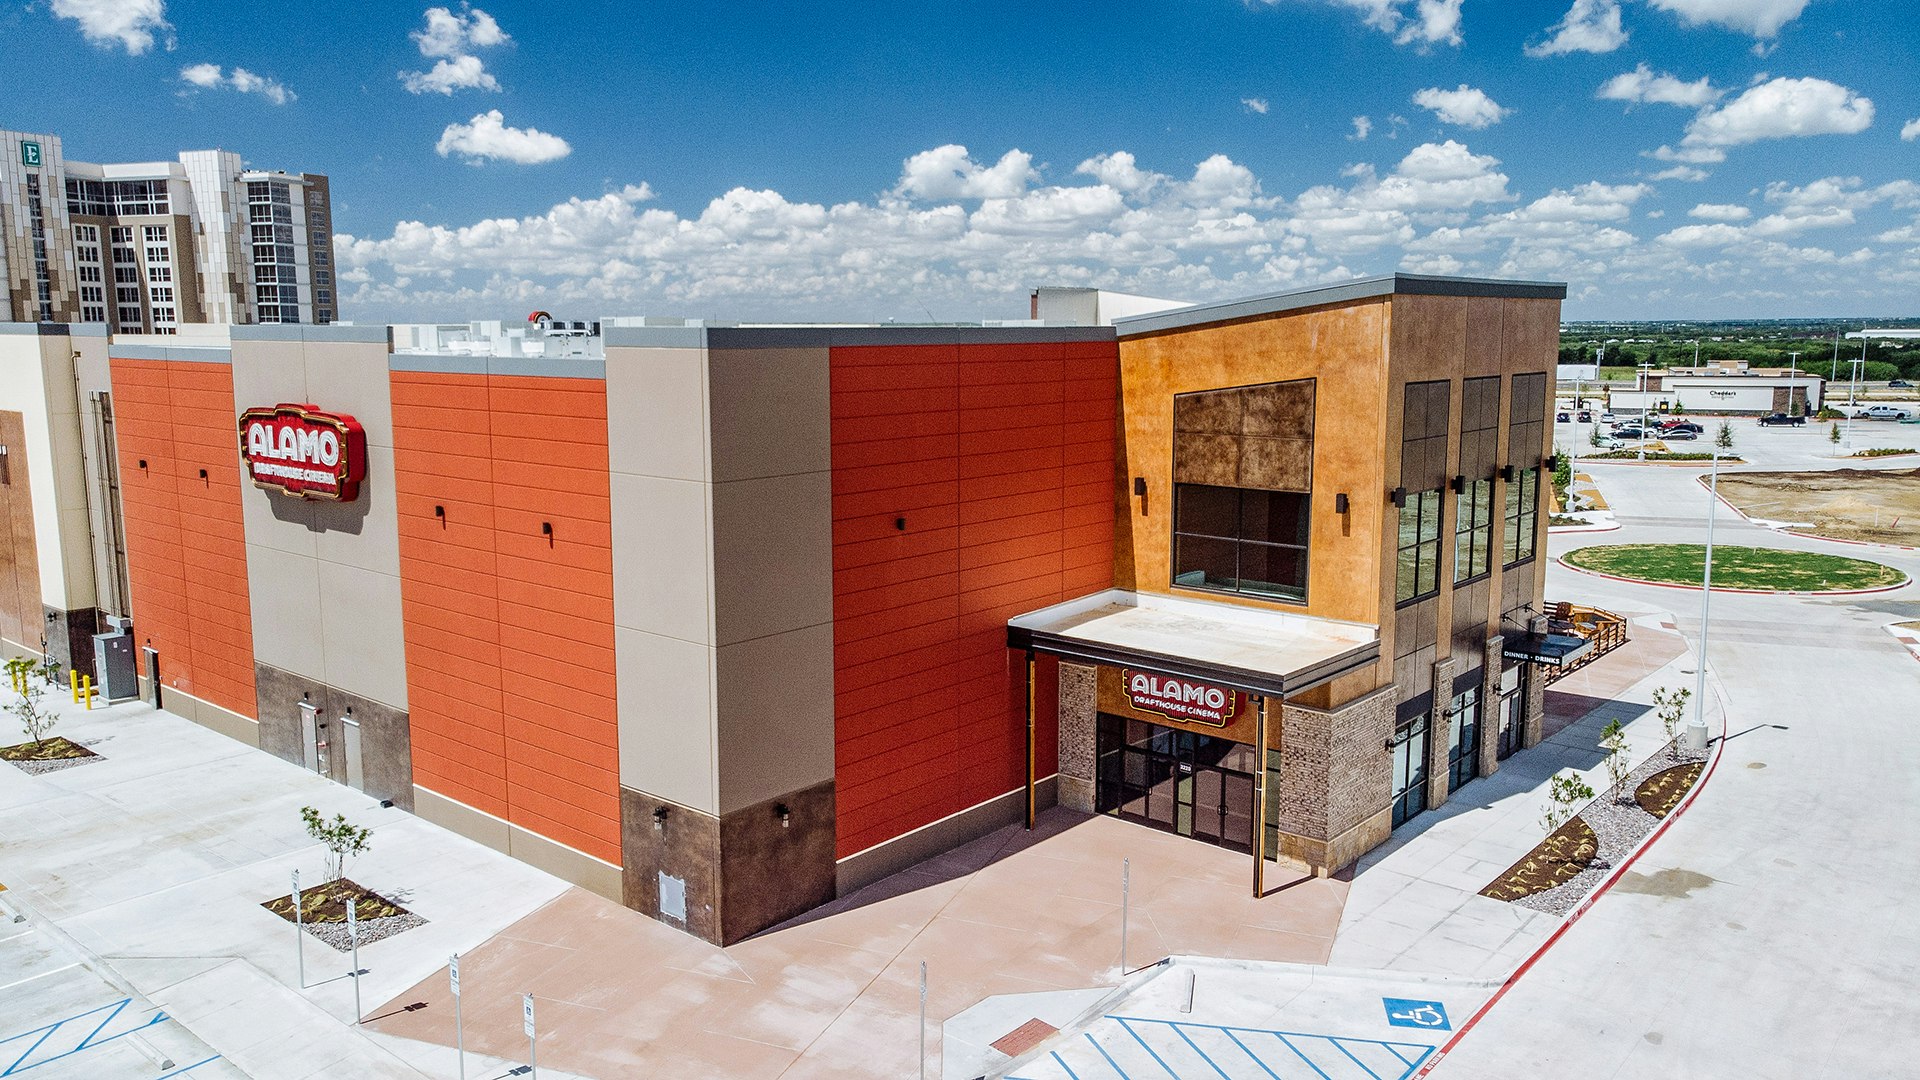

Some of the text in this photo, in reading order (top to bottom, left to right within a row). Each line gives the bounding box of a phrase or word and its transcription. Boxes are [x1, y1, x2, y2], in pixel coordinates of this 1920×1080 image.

[26, 145, 39, 163] E
[248, 422, 339, 467] ALAMO
[1504, 651, 1560, 664] DINNER DRINKS
[1131, 674, 1225, 709] ALAMO
[1134, 695, 1221, 720] DRAFTHOUSE CINEMA
